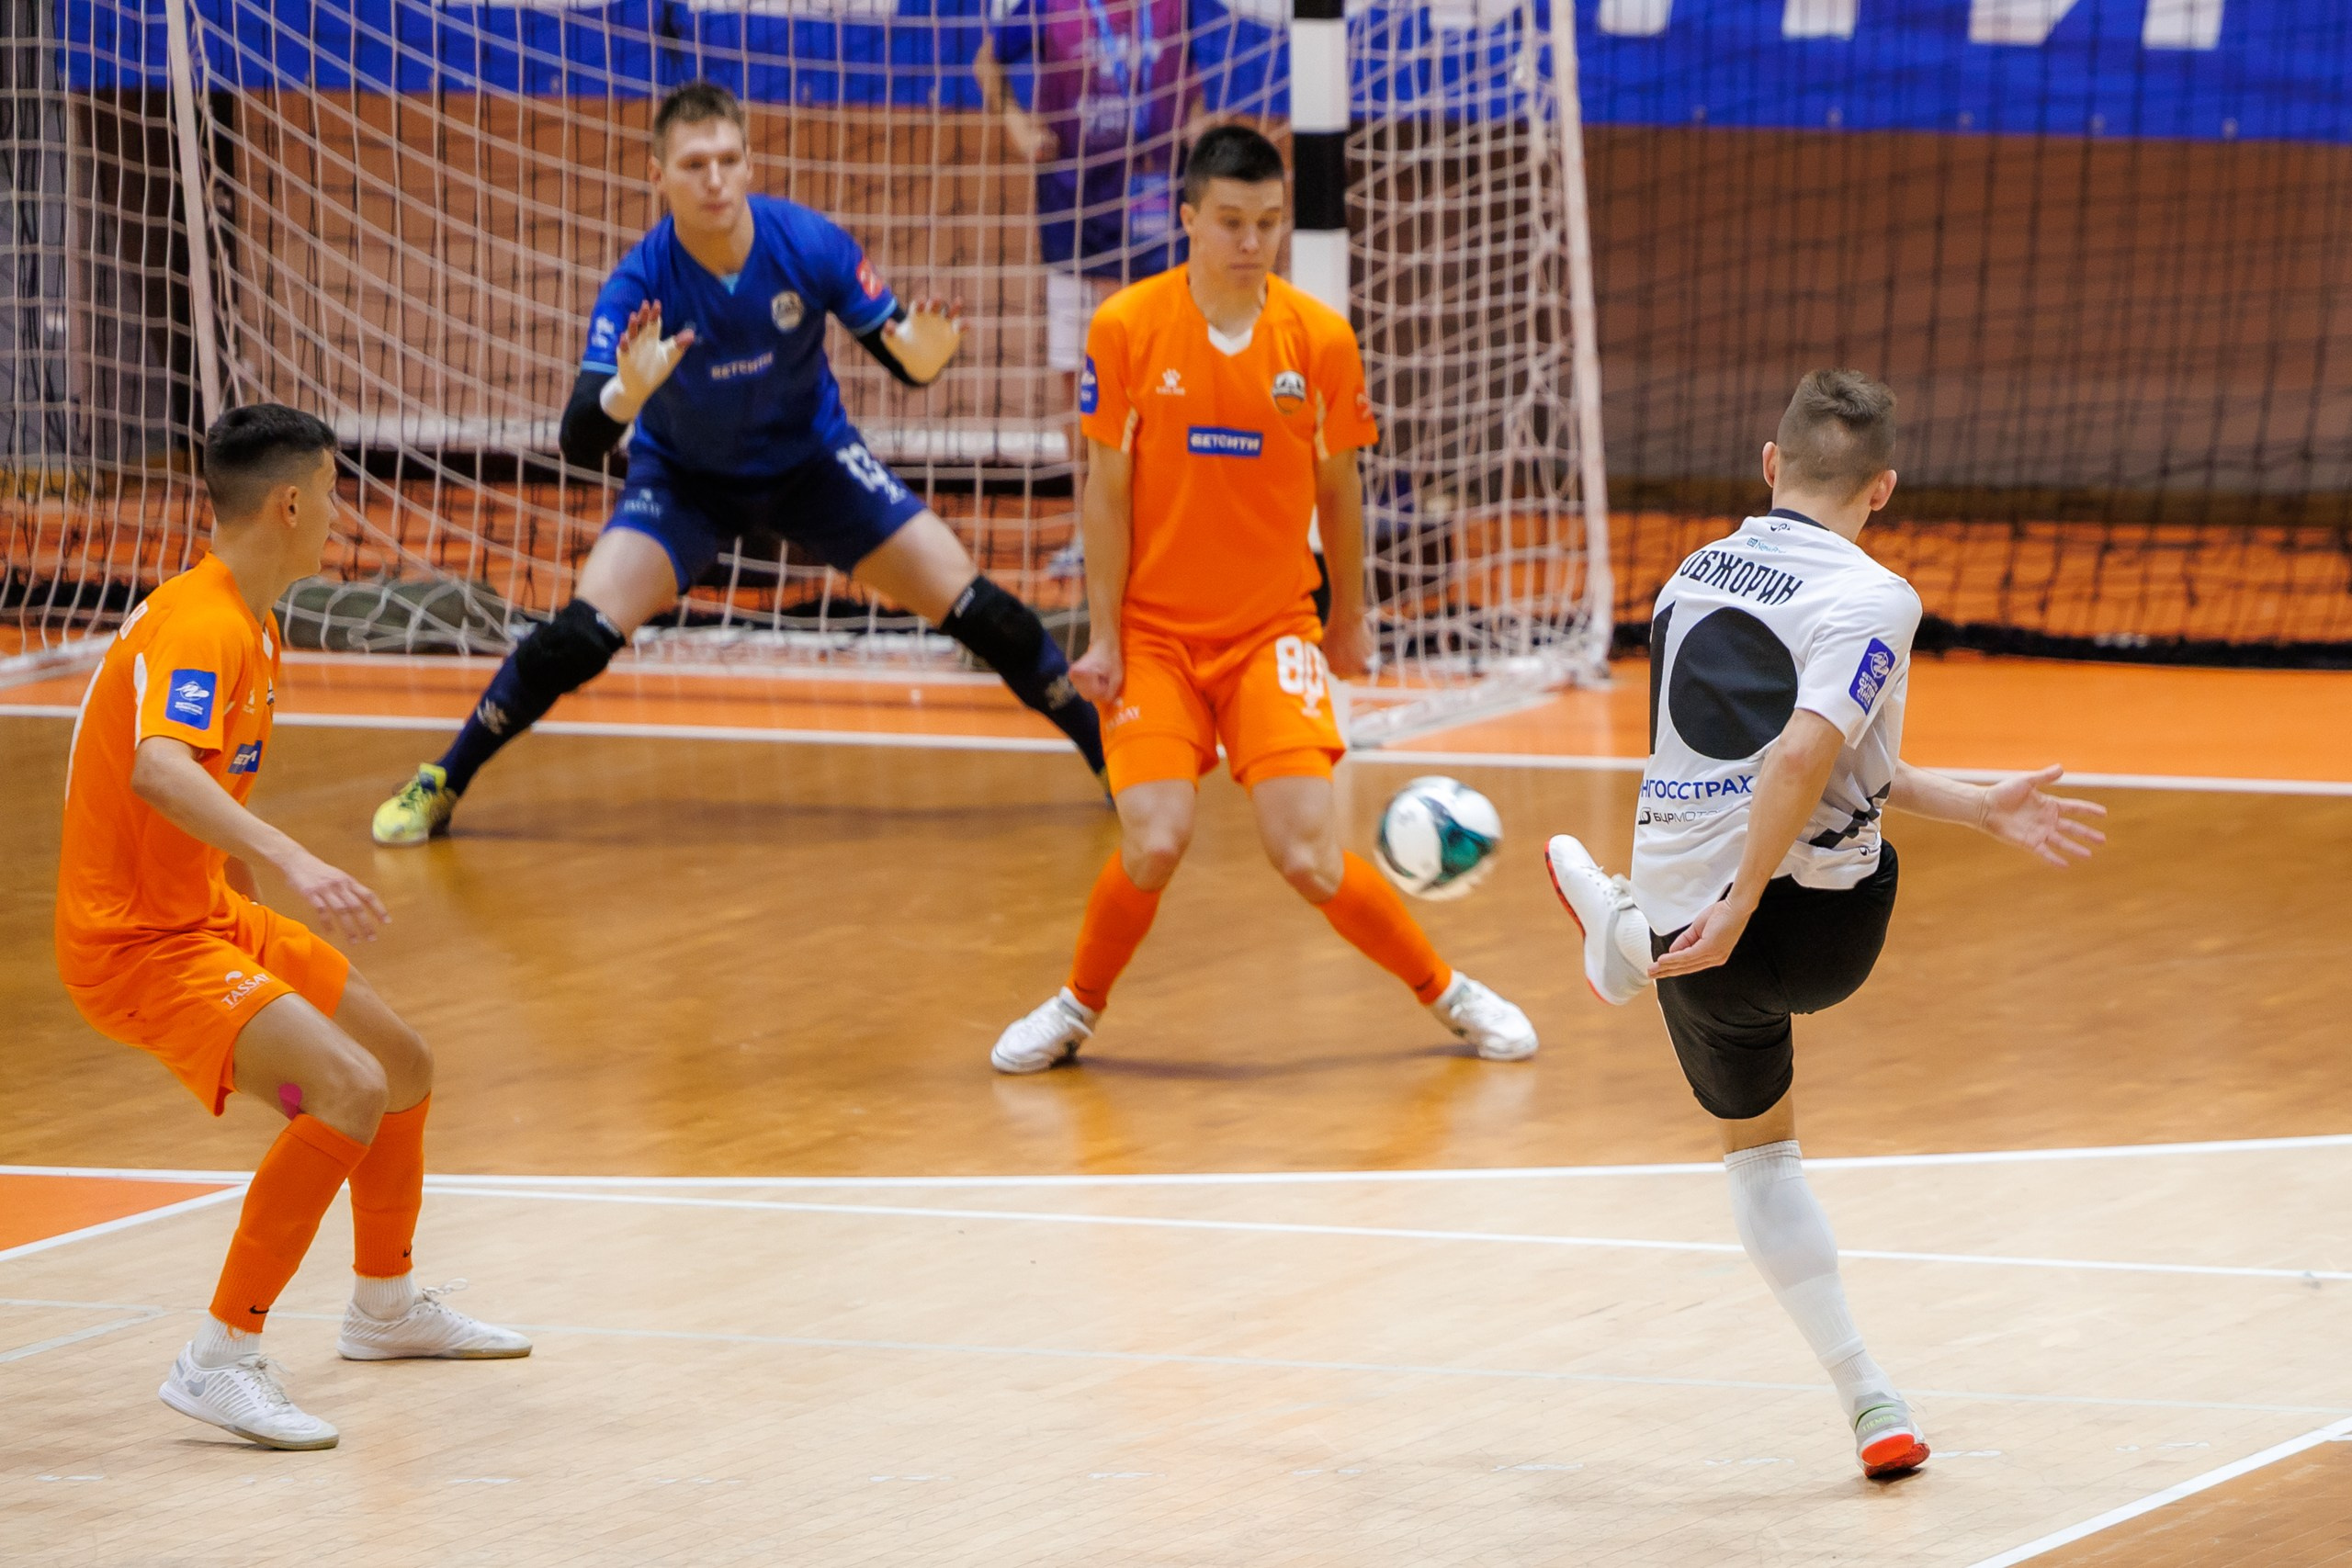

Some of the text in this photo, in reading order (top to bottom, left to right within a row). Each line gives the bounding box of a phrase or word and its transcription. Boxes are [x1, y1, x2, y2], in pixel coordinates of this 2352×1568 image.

[1679, 550, 1804, 605] ОБЖОРИН
[1275, 634, 1325, 696] 80
[1641, 775, 1754, 800] НГОССТРАХ
